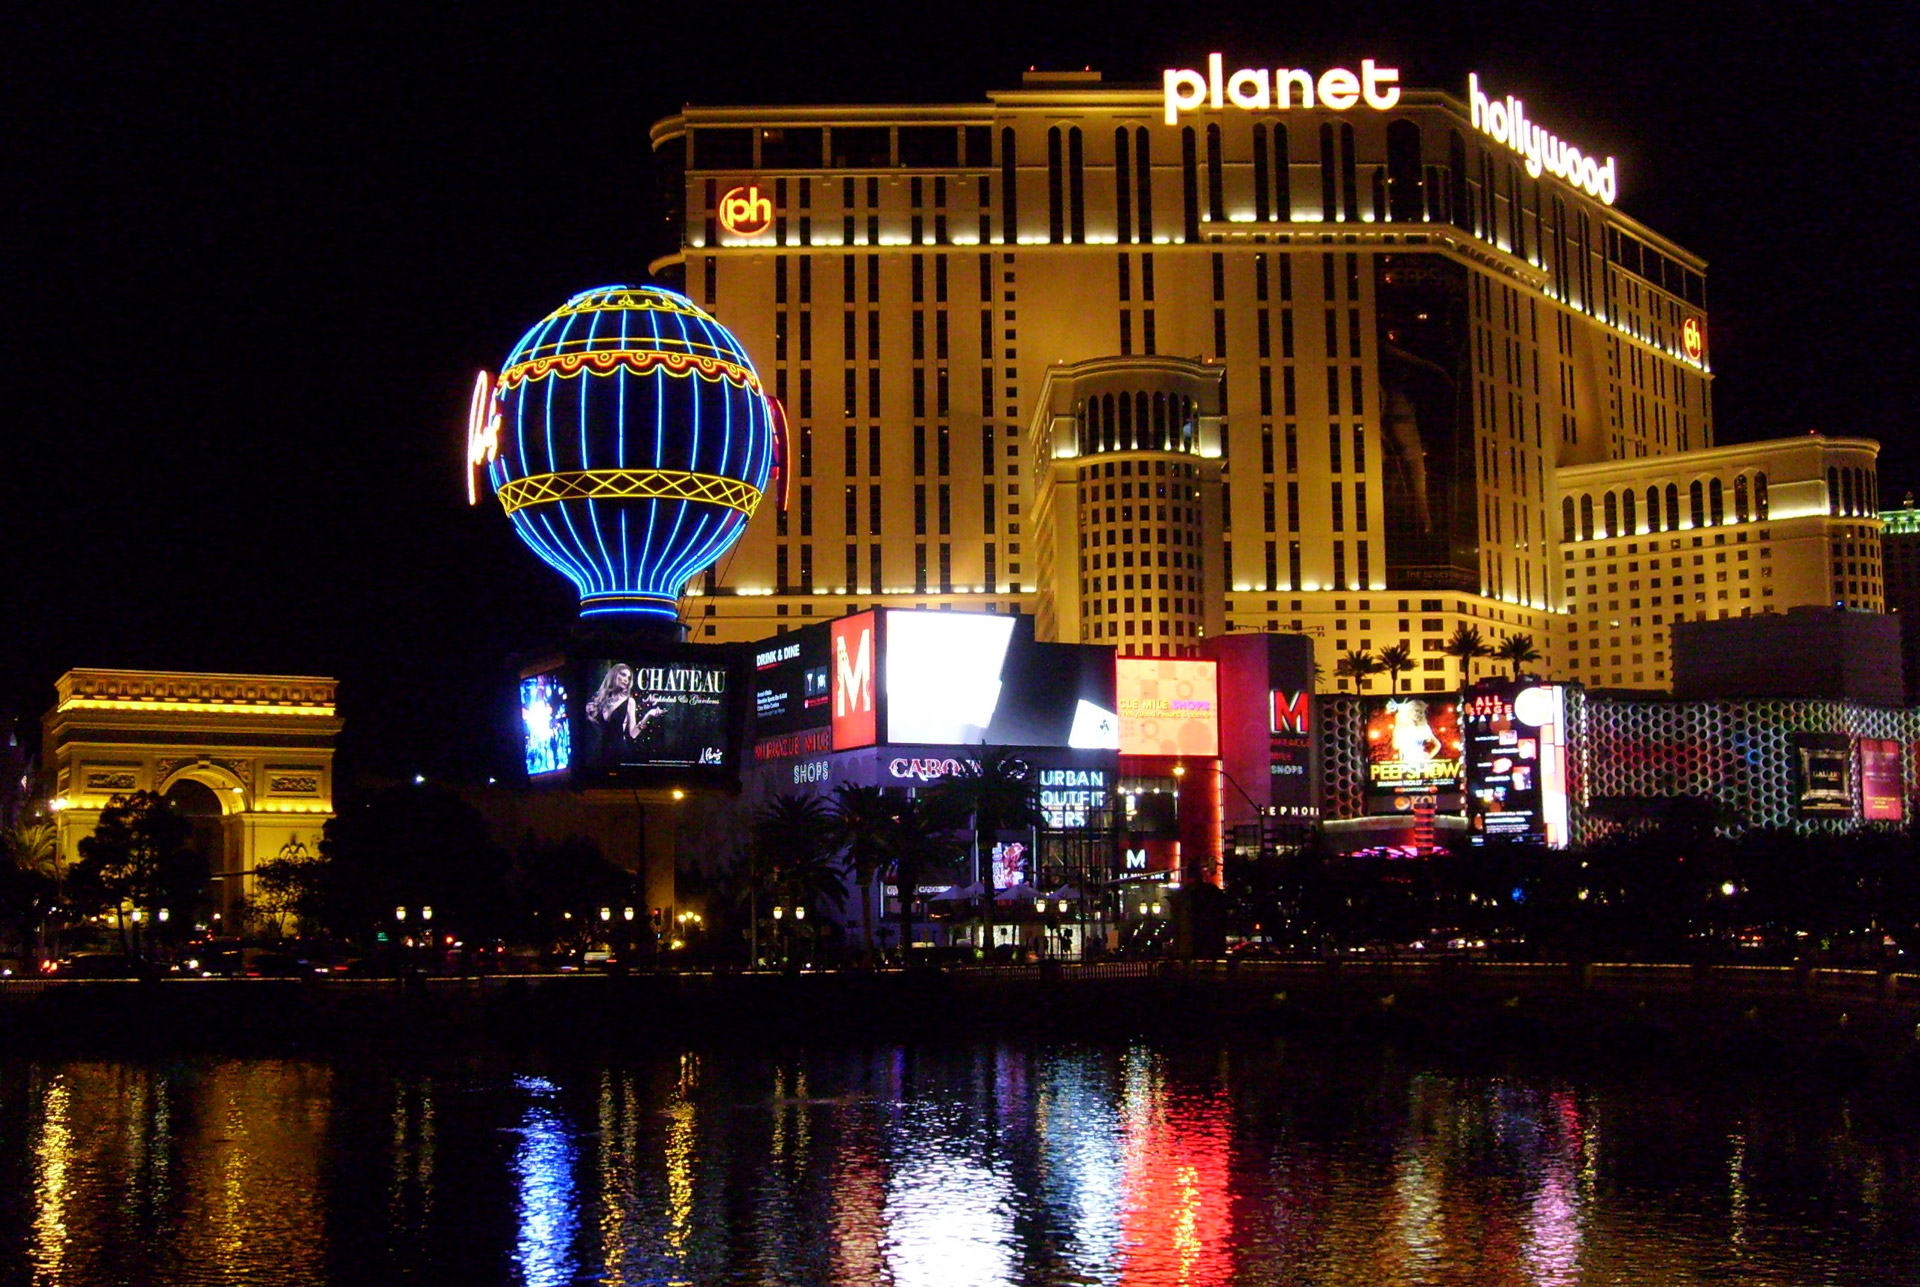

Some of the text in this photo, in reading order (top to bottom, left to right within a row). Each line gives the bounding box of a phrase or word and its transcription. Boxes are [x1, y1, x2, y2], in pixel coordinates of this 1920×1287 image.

[1163, 52, 1617, 205] planet hollywood
[726, 187, 772, 229] ph
[756, 649, 777, 667] DRINK
[777, 648, 784, 662] &
[783, 643, 800, 660] DINE
[637, 667, 727, 694] CHATEAU
[836, 628, 871, 718] M
[1142, 699, 1169, 711] MILE
[1171, 699, 1211, 711] SHOPS
[1470, 704, 1513, 716] STAGE
[1475, 694, 1503, 707] ALL
[1269, 690, 1310, 734] M
[804, 731, 829, 753] MILE
[793, 760, 829, 784] SHOPS
[889, 757, 962, 782] CABO
[1039, 769, 1105, 787] URBAN
[1271, 764, 1303, 774] SHOPS
[1370, 762, 1461, 781] PEEPSHOW
[1039, 790, 1106, 808] OUTFIT
[1126, 849, 1146, 869] M
